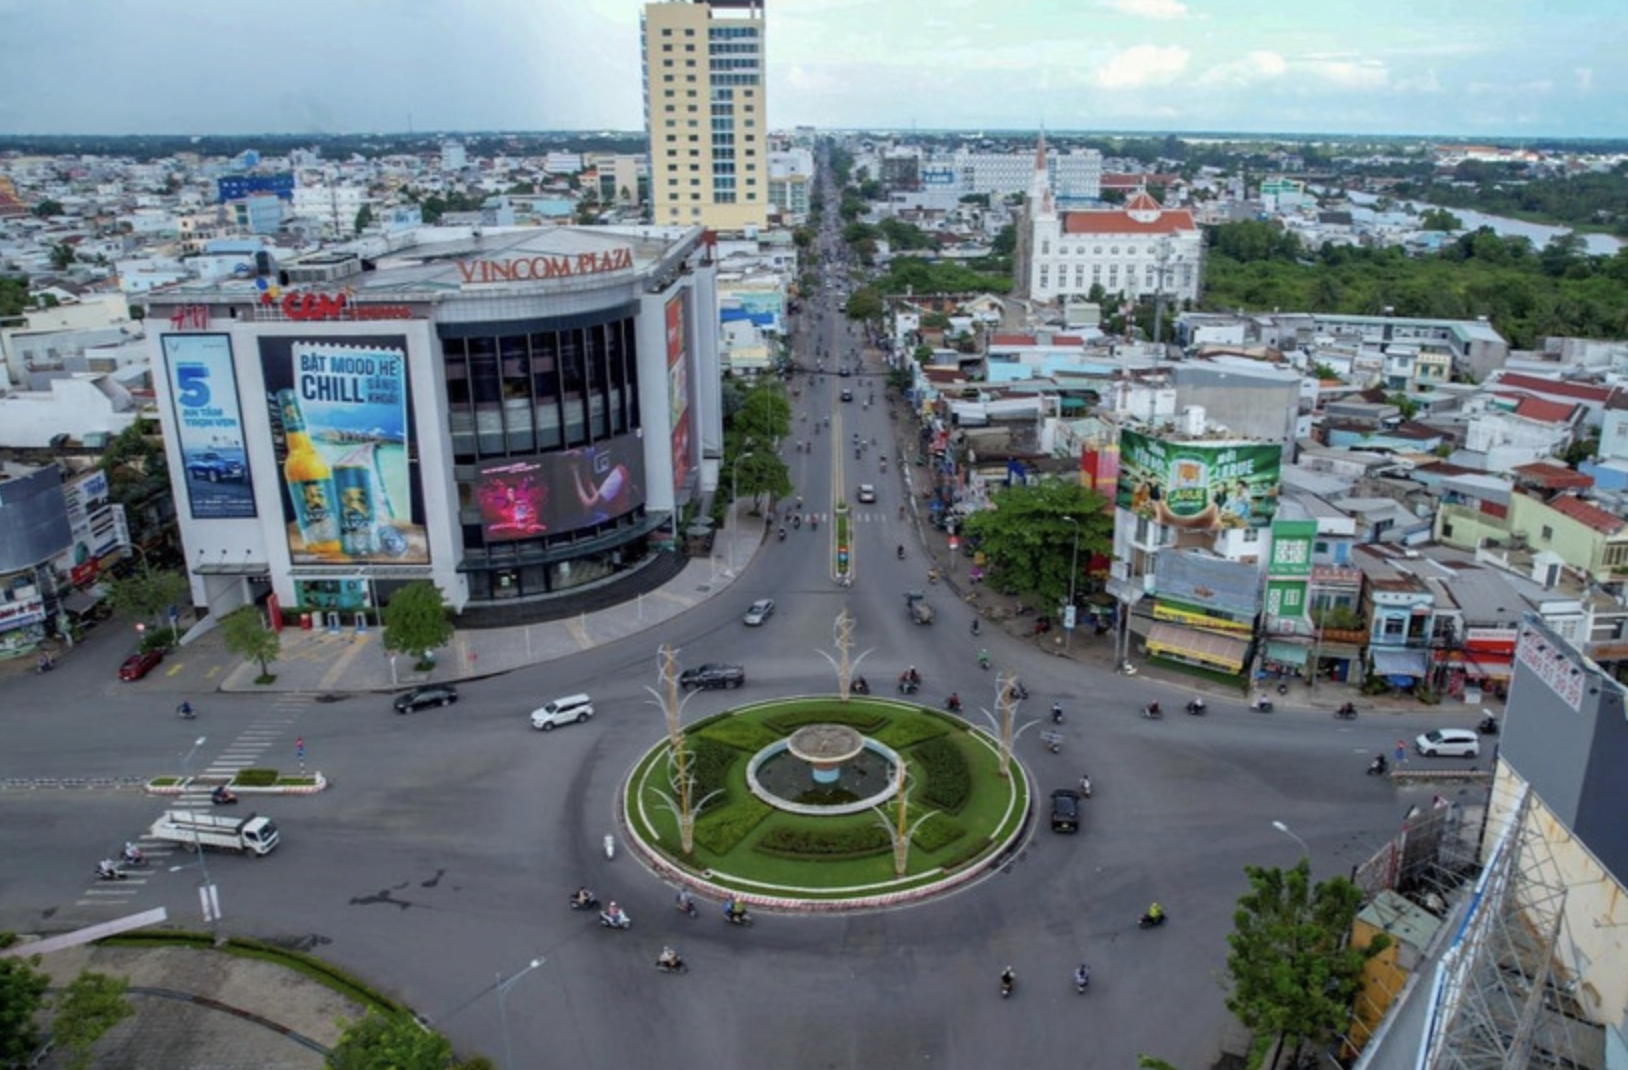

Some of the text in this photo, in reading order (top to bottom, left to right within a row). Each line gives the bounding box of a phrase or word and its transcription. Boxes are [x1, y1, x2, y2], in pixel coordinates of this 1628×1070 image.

[457, 248, 633, 283] VINCOM PLAZA
[330, 356, 374, 375] MOOD
[178, 367, 210, 408] 5
[302, 374, 364, 403] CHILL
